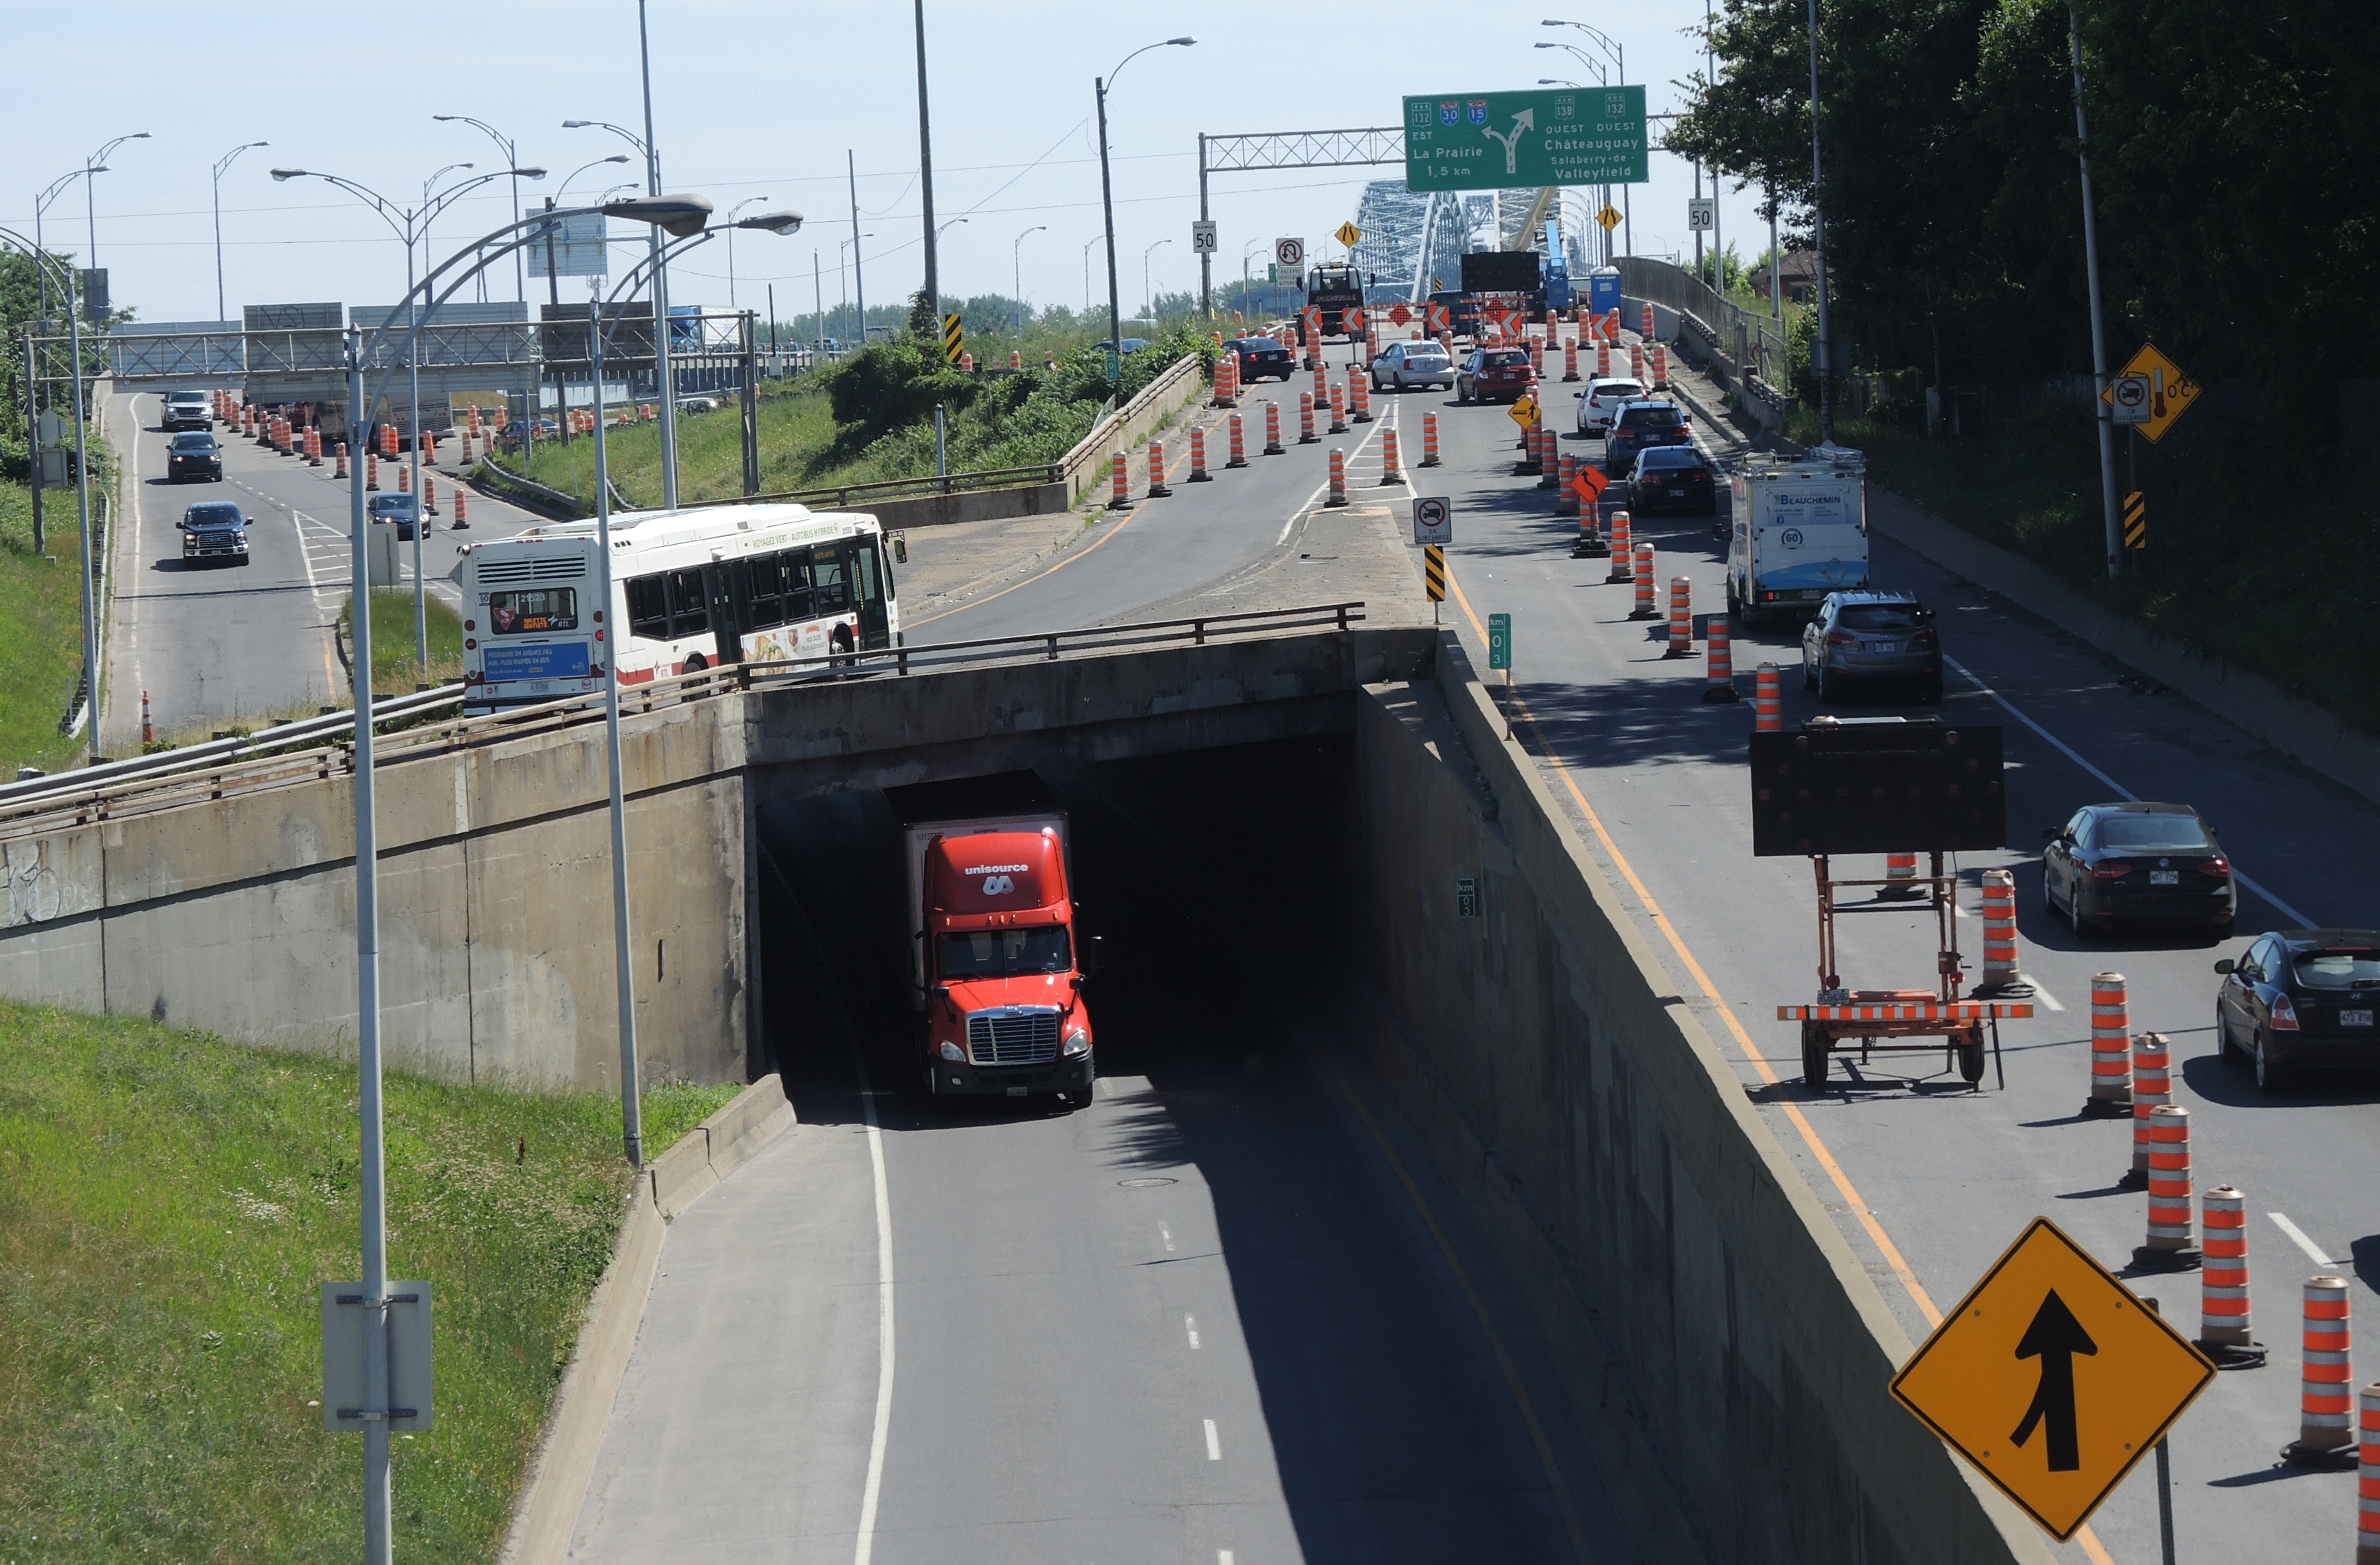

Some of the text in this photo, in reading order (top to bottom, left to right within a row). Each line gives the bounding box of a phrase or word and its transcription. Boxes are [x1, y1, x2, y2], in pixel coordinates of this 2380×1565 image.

[1470, 109, 1484, 118] 15
[1557, 106, 1572, 116] 138
[1608, 104, 1624, 113] 132
[1415, 113, 1429, 123] 132
[1443, 110, 1457, 120] 30
[1546, 124, 1584, 134] OUEST
[1597, 122, 1635, 132] OUEST
[1545, 139, 1638, 151] Châteauguay
[1414, 146, 1483, 159] La Prairie
[1428, 165, 1470, 178] 1,5 km
[1555, 166, 1631, 180] Valleyfield
[1692, 210, 1710, 225] 50
[1197, 233, 1214, 248] 50
[1780, 494, 1840, 505] BEAUCHEMIN
[752, 537, 775, 548] VOYAGEZ
[776, 535, 788, 543] VERT
[791, 530, 814, 540] AUTOBUS
[1785, 533, 1798, 543] 60
[521, 593, 546, 603] 21523
[965, 863, 1029, 876] unisource
[1458, 883, 1473, 892] km
